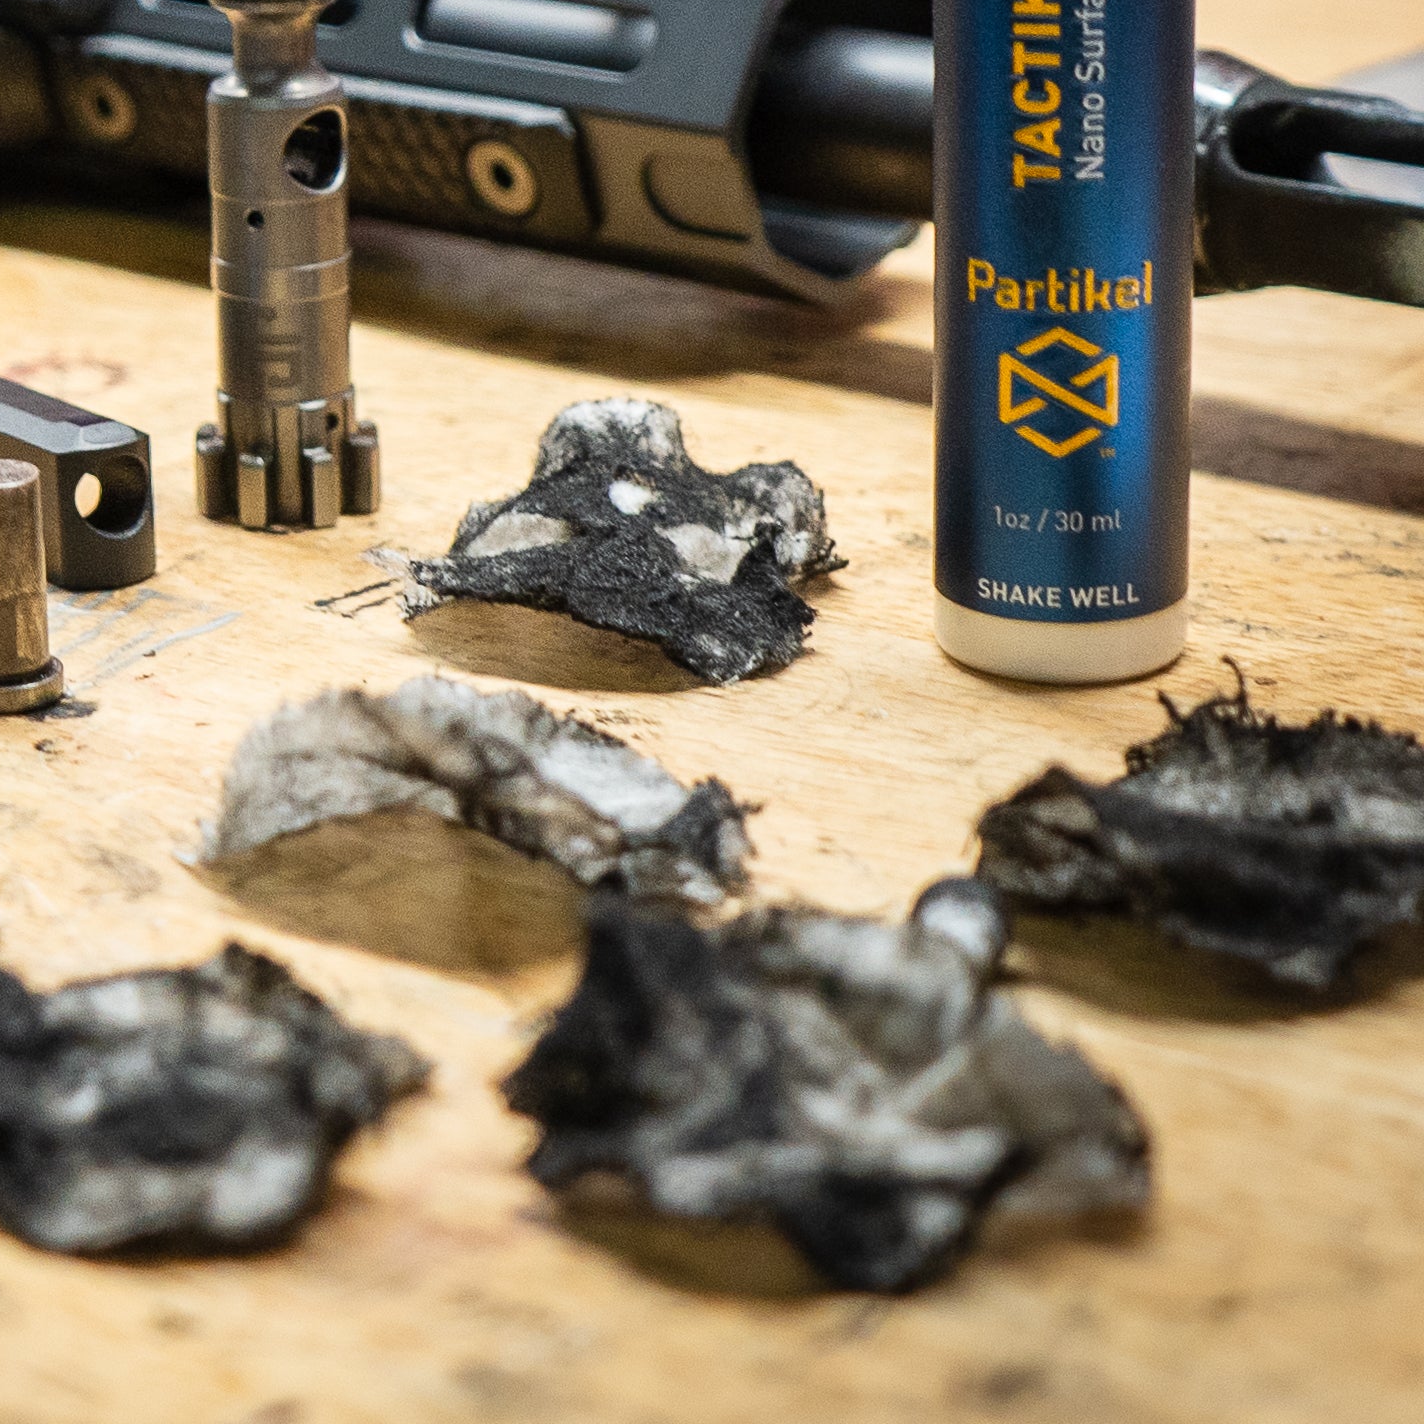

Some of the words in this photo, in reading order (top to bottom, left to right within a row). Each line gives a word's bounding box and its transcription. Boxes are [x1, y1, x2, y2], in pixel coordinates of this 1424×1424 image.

[1074, 92, 1106, 180] Nano
[967, 257, 1154, 314] Partikel
[993, 505, 1031, 531] 1oz
[1054, 509, 1084, 533] 30
[1091, 508, 1122, 532] ml
[978, 578, 1063, 609] SHAKE
[1069, 582, 1141, 610] WELL
